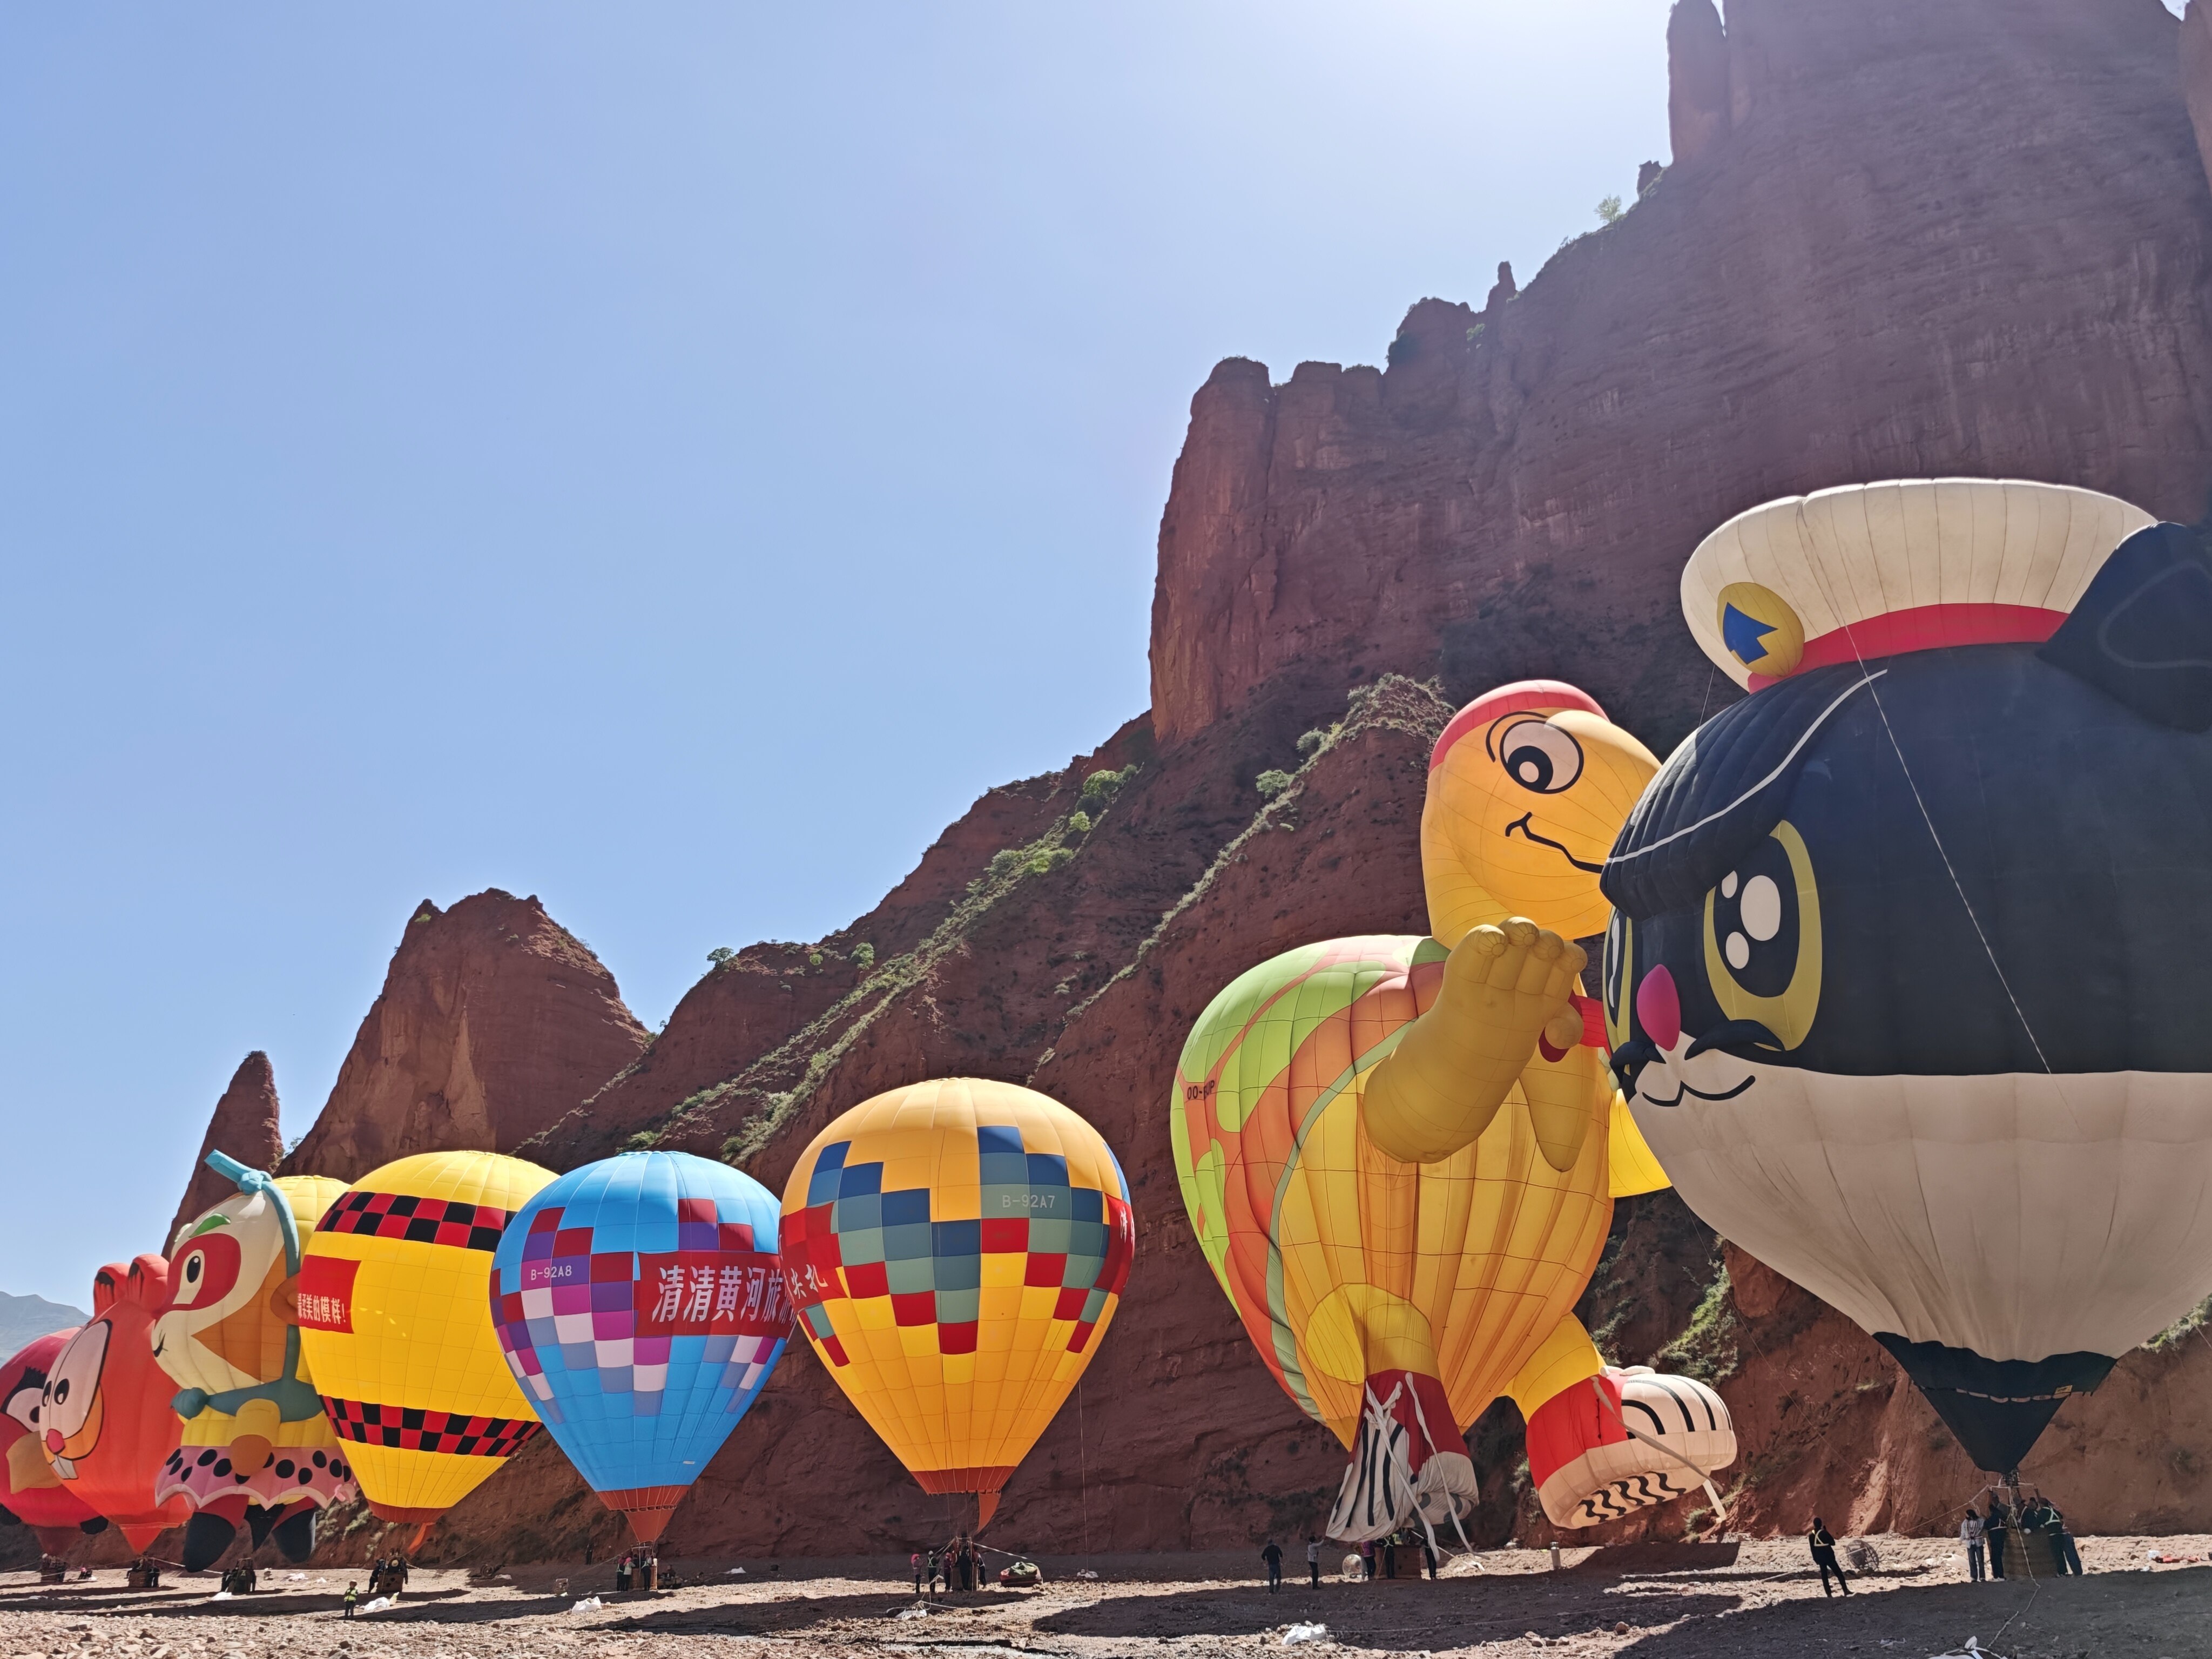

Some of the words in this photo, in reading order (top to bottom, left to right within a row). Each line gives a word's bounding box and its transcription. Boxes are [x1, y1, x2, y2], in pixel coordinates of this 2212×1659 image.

[1002, 1195, 1055, 1209] B-92A7
[530, 1265, 572, 1281] B-92A8
[652, 1265, 797, 1326] 清清黄河旅
